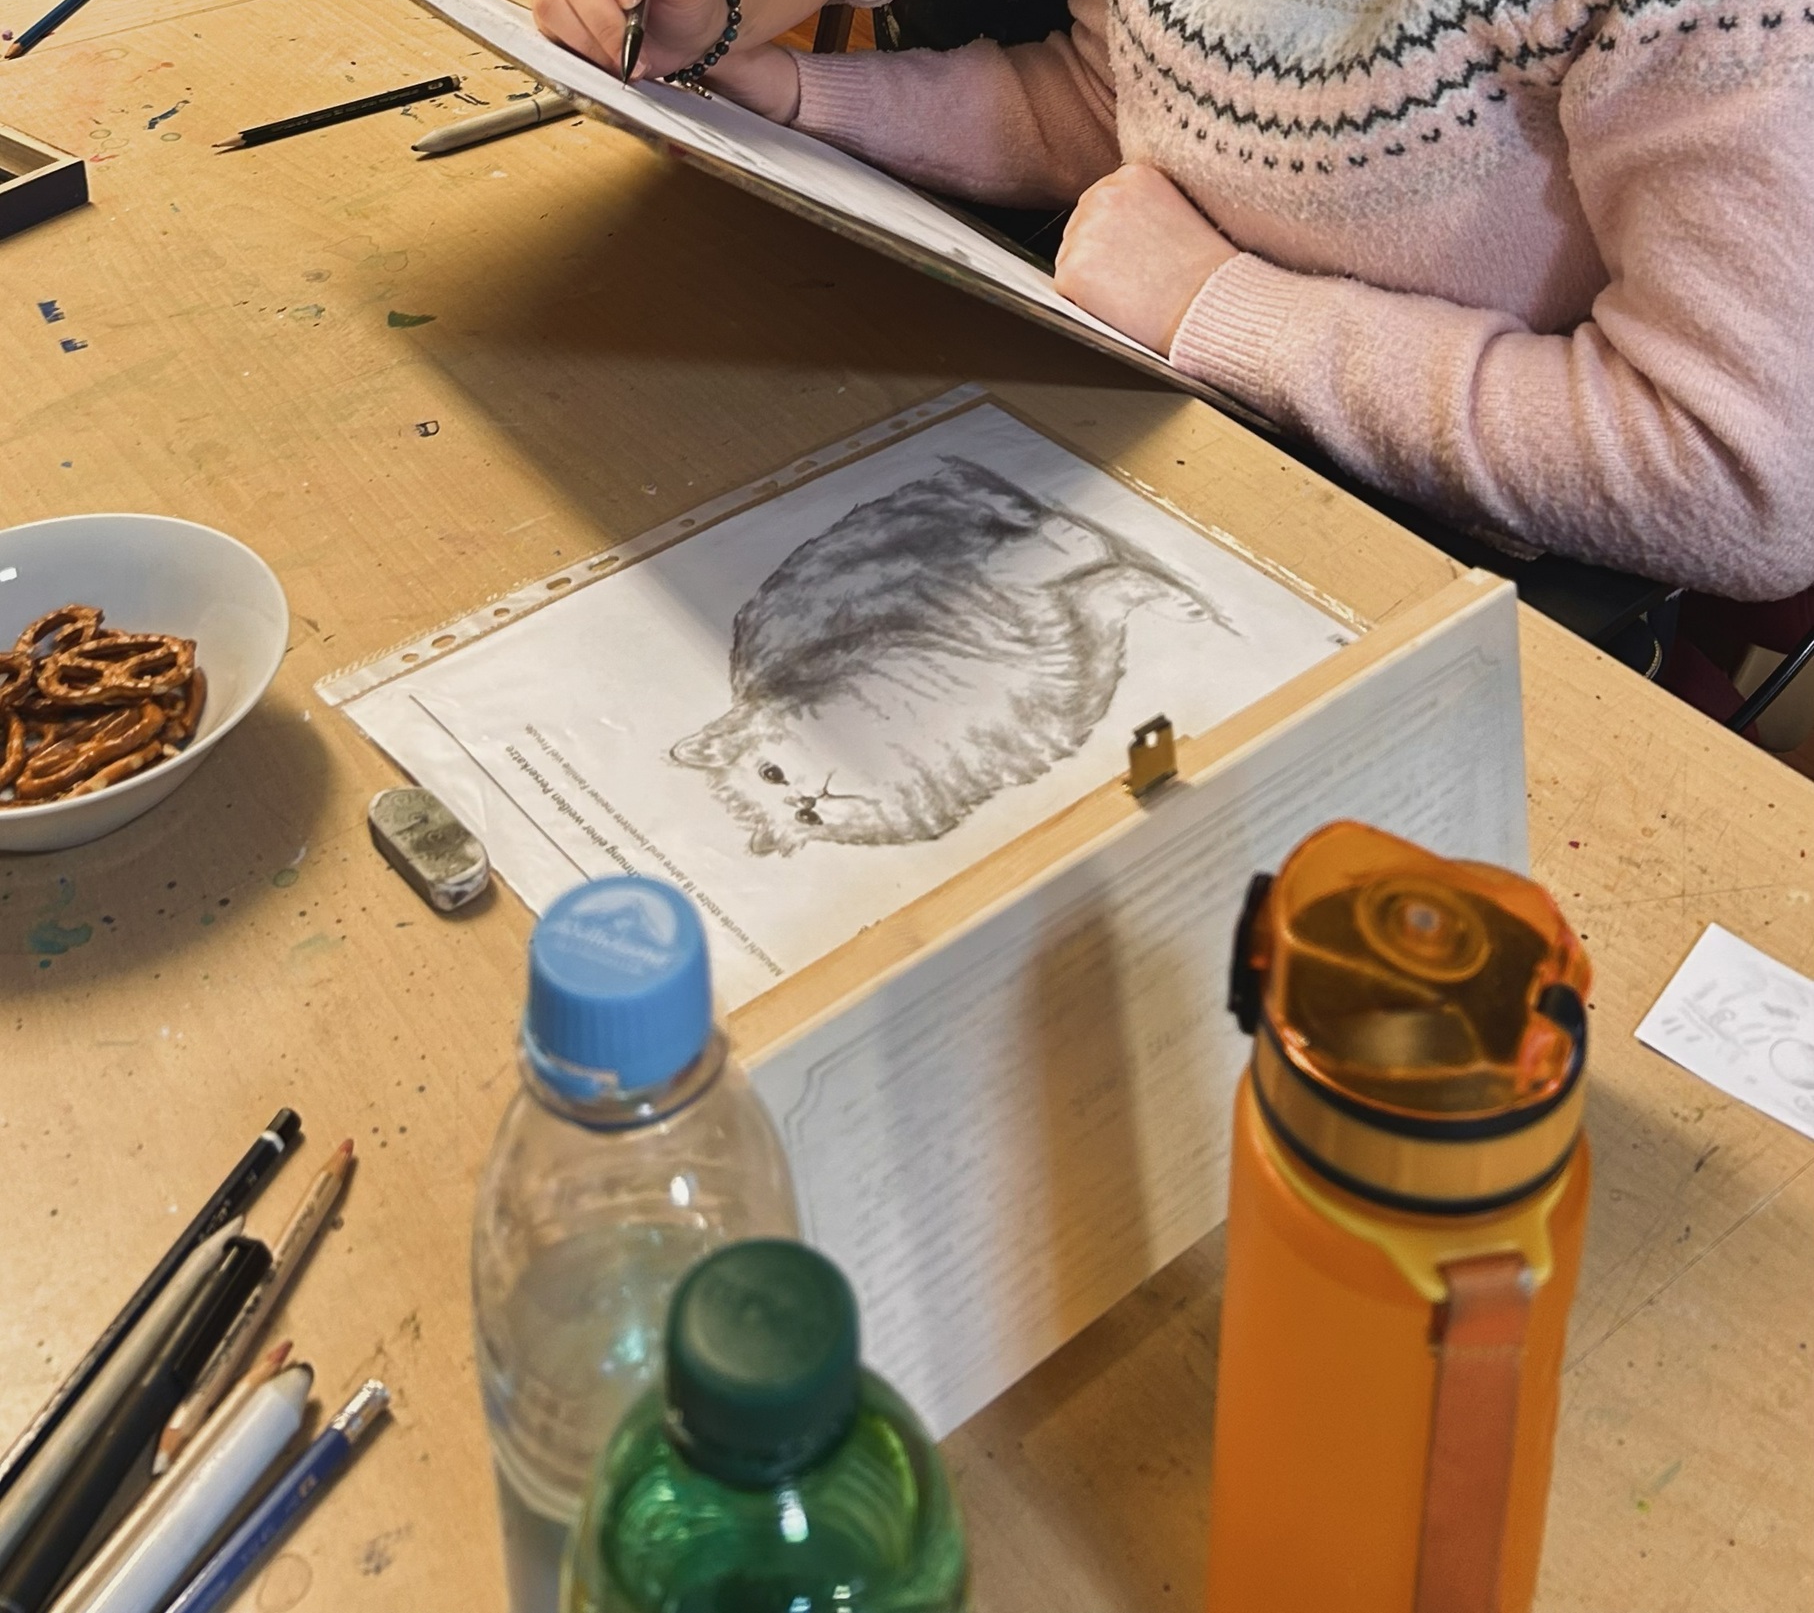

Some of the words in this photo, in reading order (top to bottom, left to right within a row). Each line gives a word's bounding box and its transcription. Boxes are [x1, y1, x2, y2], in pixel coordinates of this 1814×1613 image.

[547, 748, 564, 764] viel
[505, 745, 554, 795] Perserkatze
[562, 762, 590, 791] Familie
[551, 792, 585, 826] weißen
[587, 789, 616, 815] meiner
[582, 825, 608, 848] einer
[613, 813, 651, 847] bereitete
[645, 844, 666, 861] und
[663, 860, 690, 883] Jahre
[683, 881, 697, 894] 18
[696, 892, 723, 917] stolze
[720, 916, 749, 944] wurde
